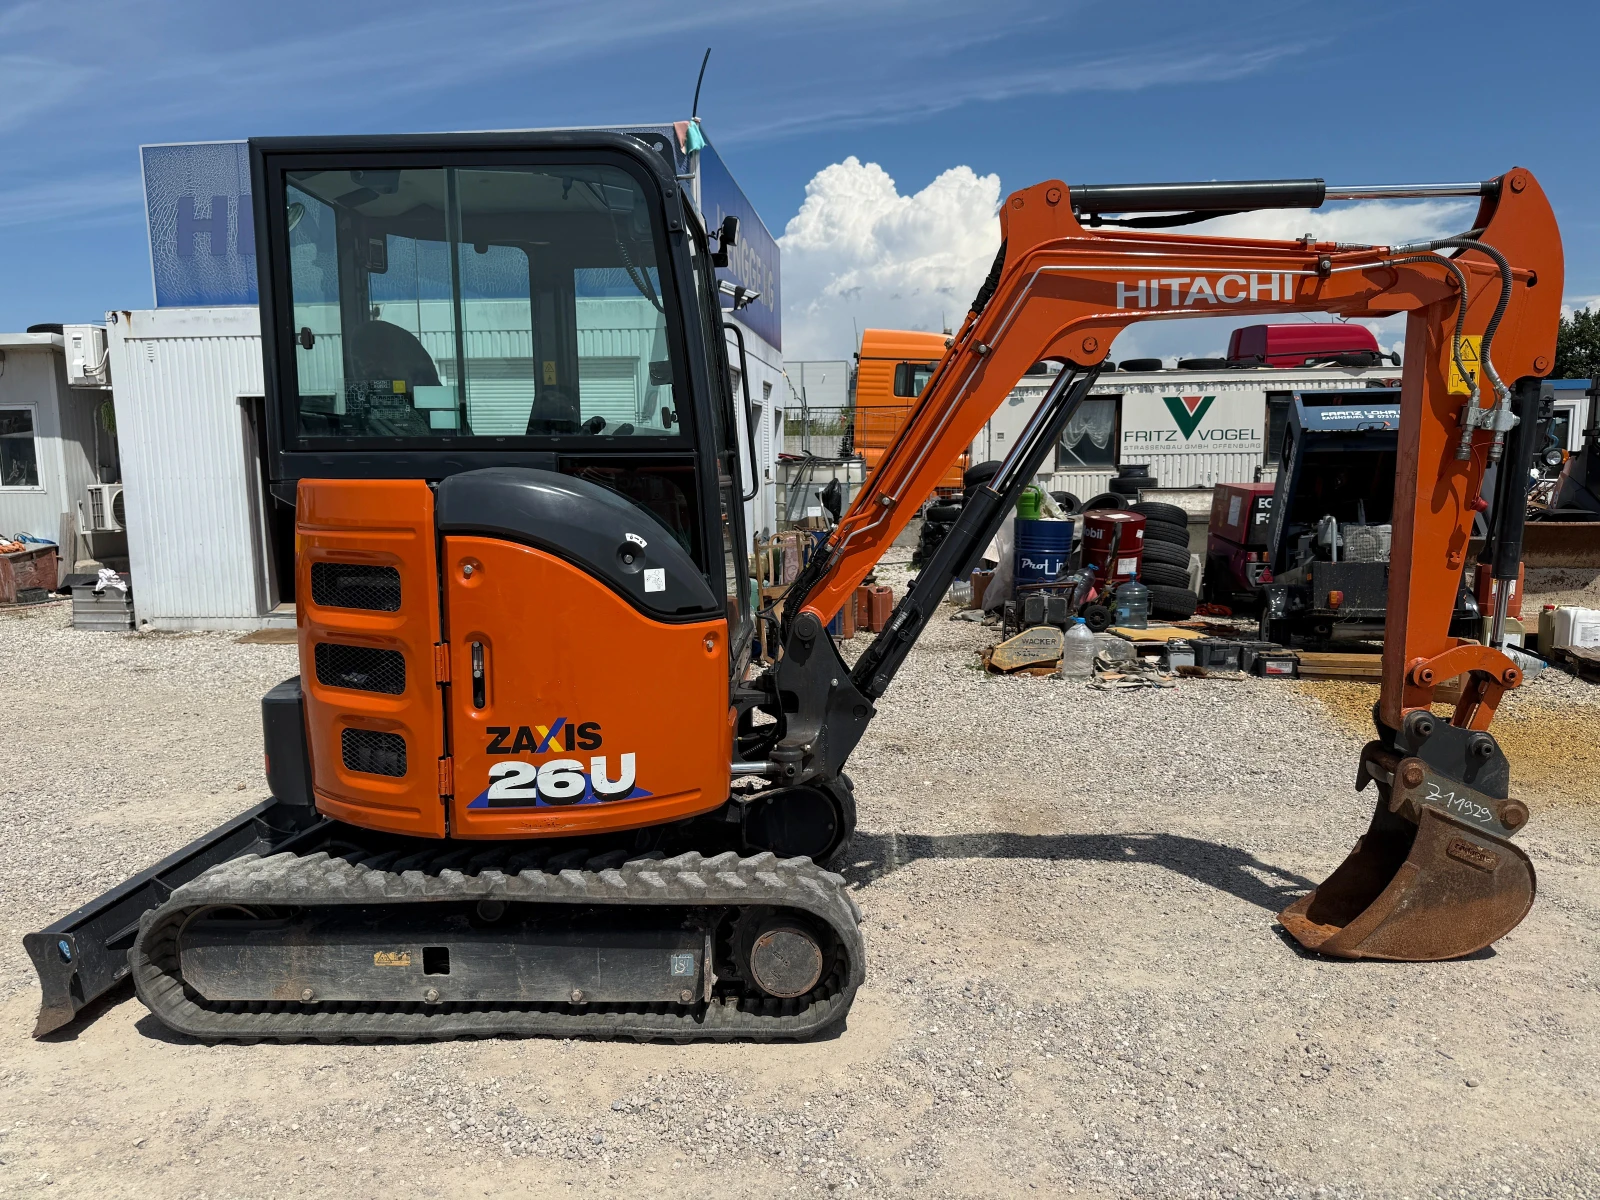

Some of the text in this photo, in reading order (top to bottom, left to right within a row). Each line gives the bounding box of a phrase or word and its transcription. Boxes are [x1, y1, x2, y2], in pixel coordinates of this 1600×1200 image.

[1116, 273, 1293, 309] HITACHI
[1124, 428, 1261, 442] FRITZ VOGEL
[1083, 525, 1103, 539] obil
[1021, 638, 1057, 646] WACKER
[485, 717, 603, 755] ZAXIS
[487, 752, 636, 807] 26U
